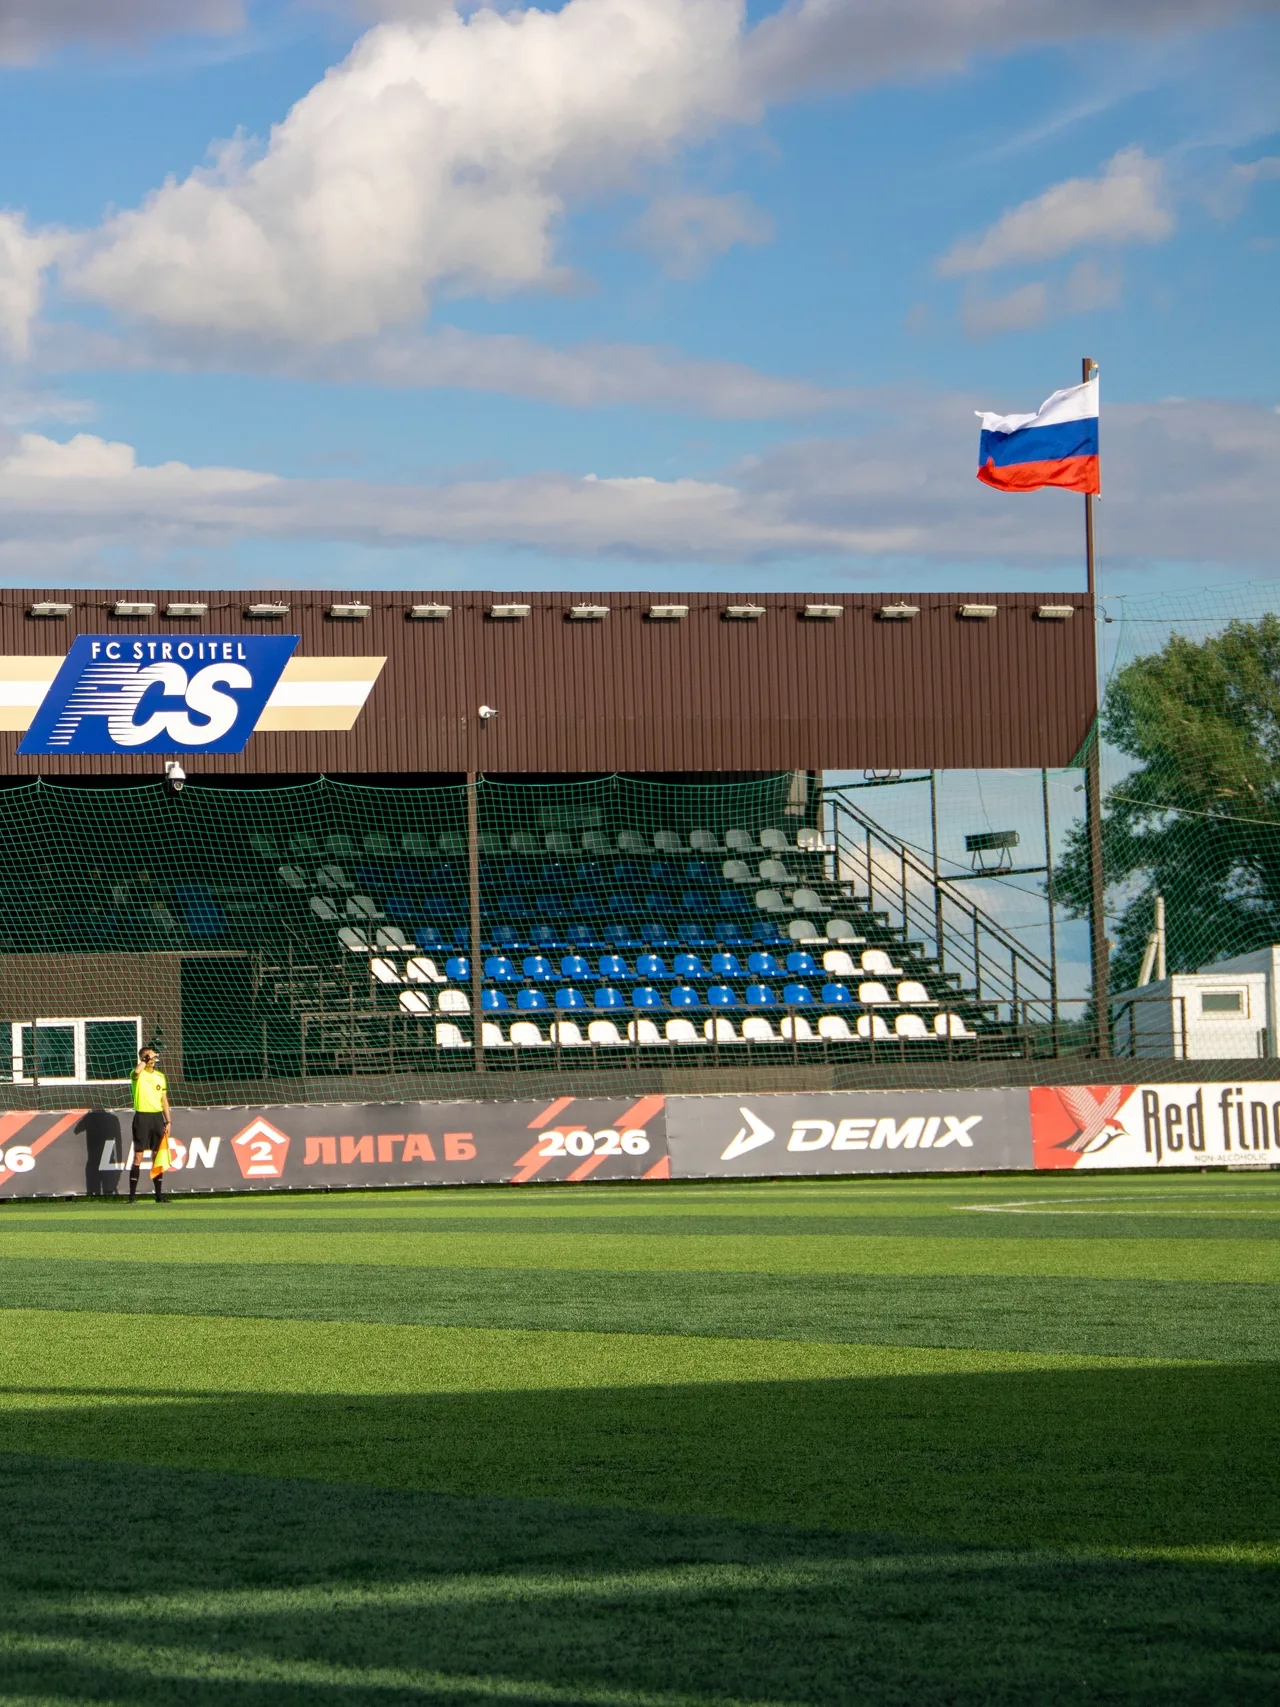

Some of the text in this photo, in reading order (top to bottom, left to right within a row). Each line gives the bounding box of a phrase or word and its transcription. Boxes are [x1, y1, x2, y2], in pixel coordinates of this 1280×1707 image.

[92, 641, 247, 660] FC STROITEL
[787, 1115, 983, 1152] DEMIX
[1141, 1087, 1206, 1164] Red
[250, 1132, 477, 1165] 2 ЛИГА Б
[538, 1129, 650, 1157] 2026
